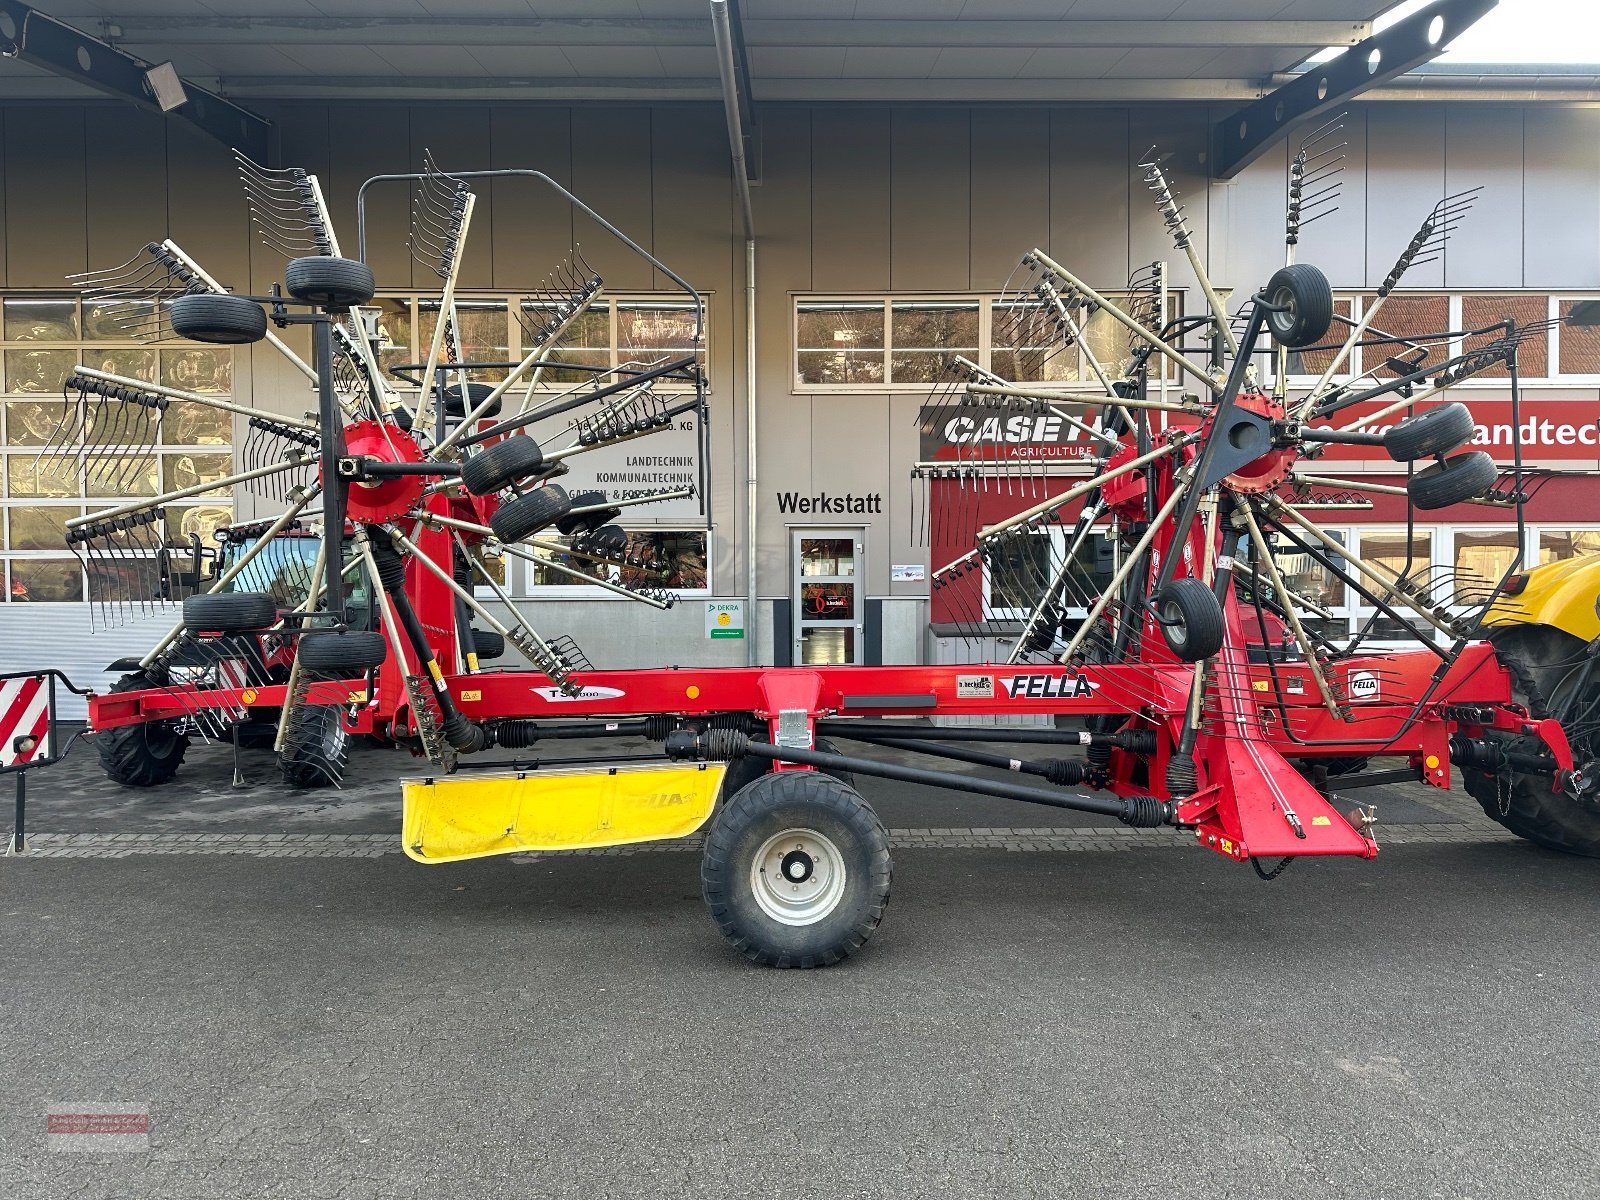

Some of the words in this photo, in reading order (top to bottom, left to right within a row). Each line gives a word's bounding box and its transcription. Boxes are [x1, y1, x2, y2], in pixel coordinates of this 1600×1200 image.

[680, 421, 693, 431] KG
[944, 416, 1062, 443] CASE
[1465, 416, 1600, 446] andtec
[1011, 446, 1093, 457] AGRICULTURE
[626, 456, 694, 467] LANDTECHNIK
[596, 472, 694, 483] KOMMUNALTECHNIK
[612, 489, 620, 499] &
[776, 491, 882, 514] Werkstatt
[1010, 674, 1094, 699] FELLA
[1353, 680, 1377, 689] FELLA
